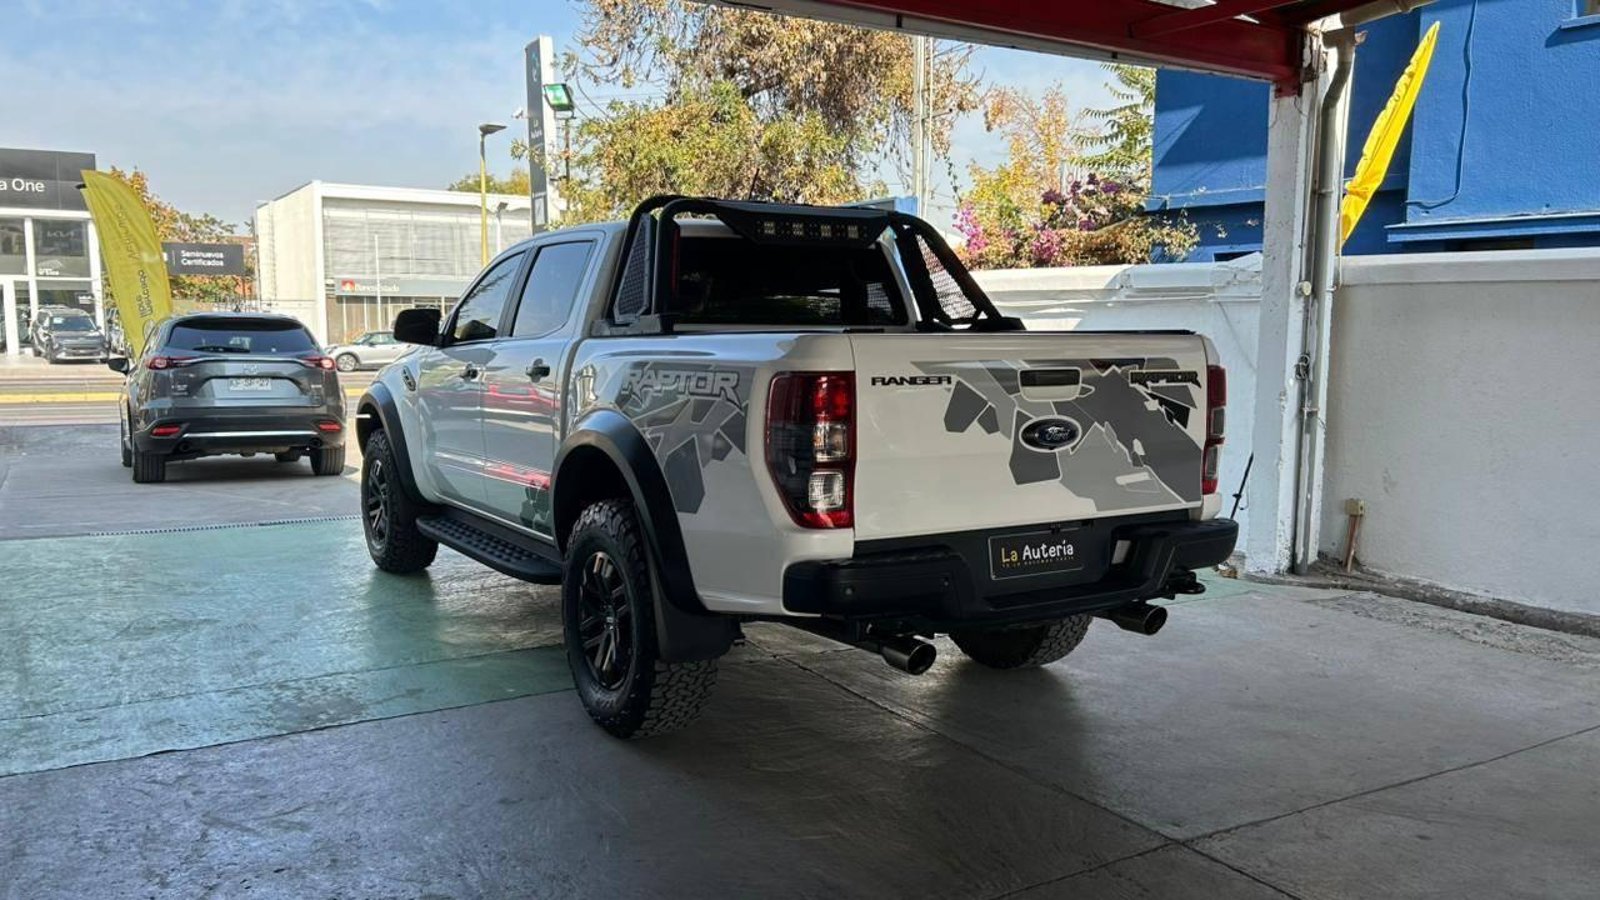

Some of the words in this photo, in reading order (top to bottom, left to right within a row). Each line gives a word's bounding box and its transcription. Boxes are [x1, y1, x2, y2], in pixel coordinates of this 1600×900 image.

[11, 178, 46, 193] One
[180, 250, 225, 259] Seminuevos
[180, 258, 225, 267] Certificados
[871, 376, 952, 386] RANGER
[621, 369, 743, 410] RAPTOR
[1001, 547, 1018, 563] La
[1022, 539, 1074, 560] Autería
